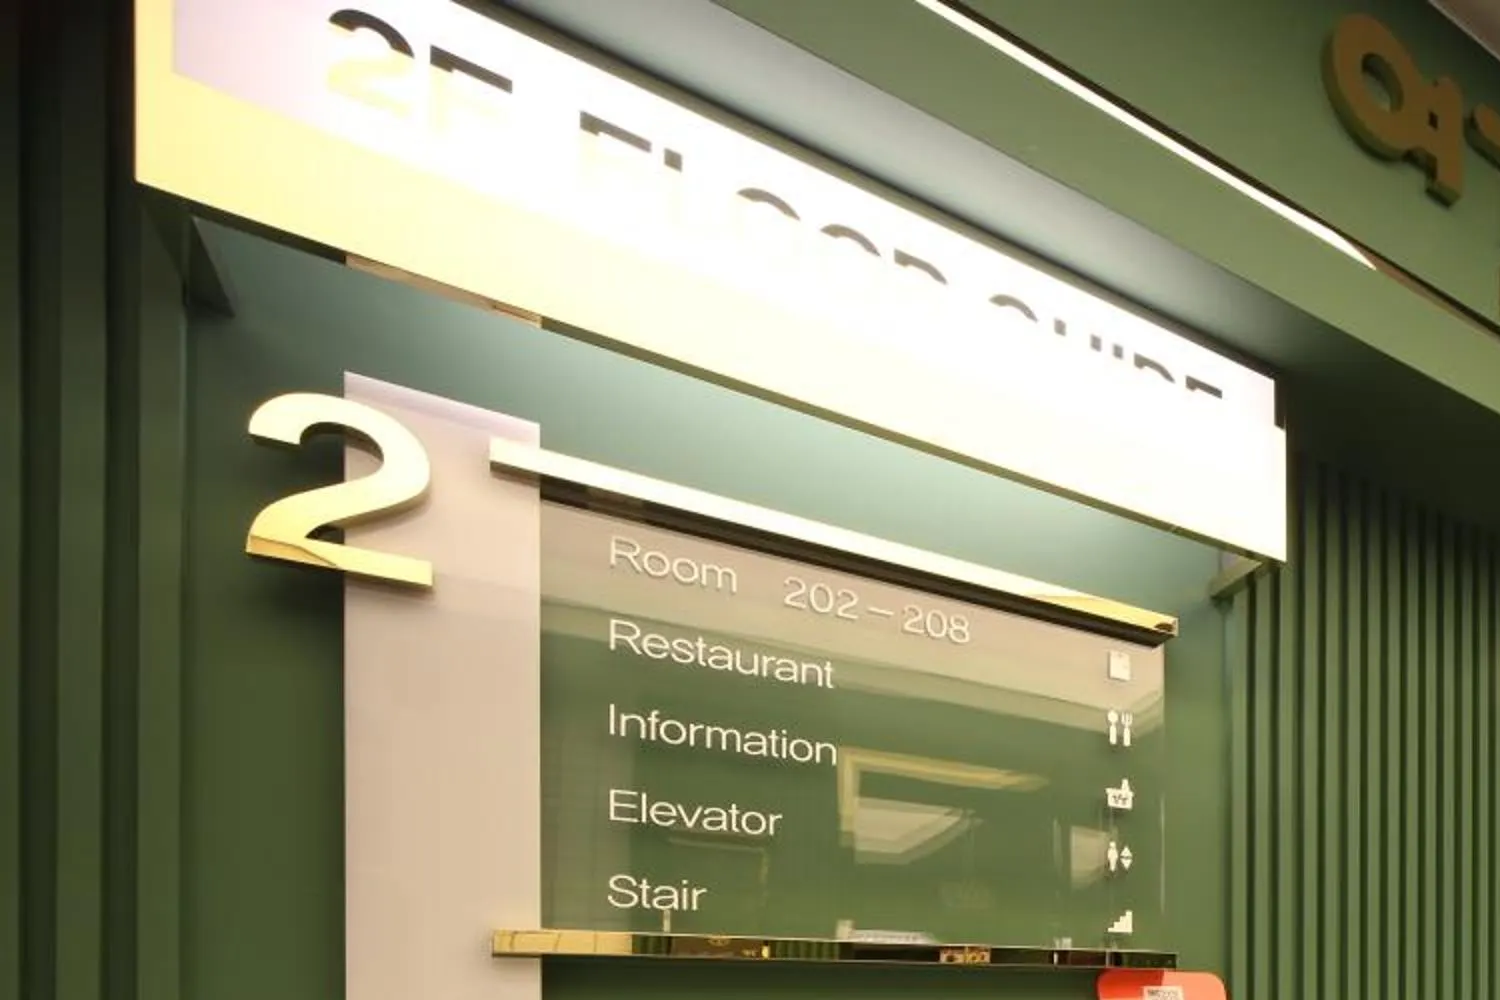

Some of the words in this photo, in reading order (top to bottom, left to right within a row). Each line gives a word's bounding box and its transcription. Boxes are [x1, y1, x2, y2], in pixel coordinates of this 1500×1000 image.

[246, 392, 434, 586] 2
[609, 536, 738, 593] Room
[609, 618, 834, 689] Restaurant
[609, 704, 838, 766] Information
[608, 790, 783, 837] Elevator
[607, 874, 708, 912] Stair
